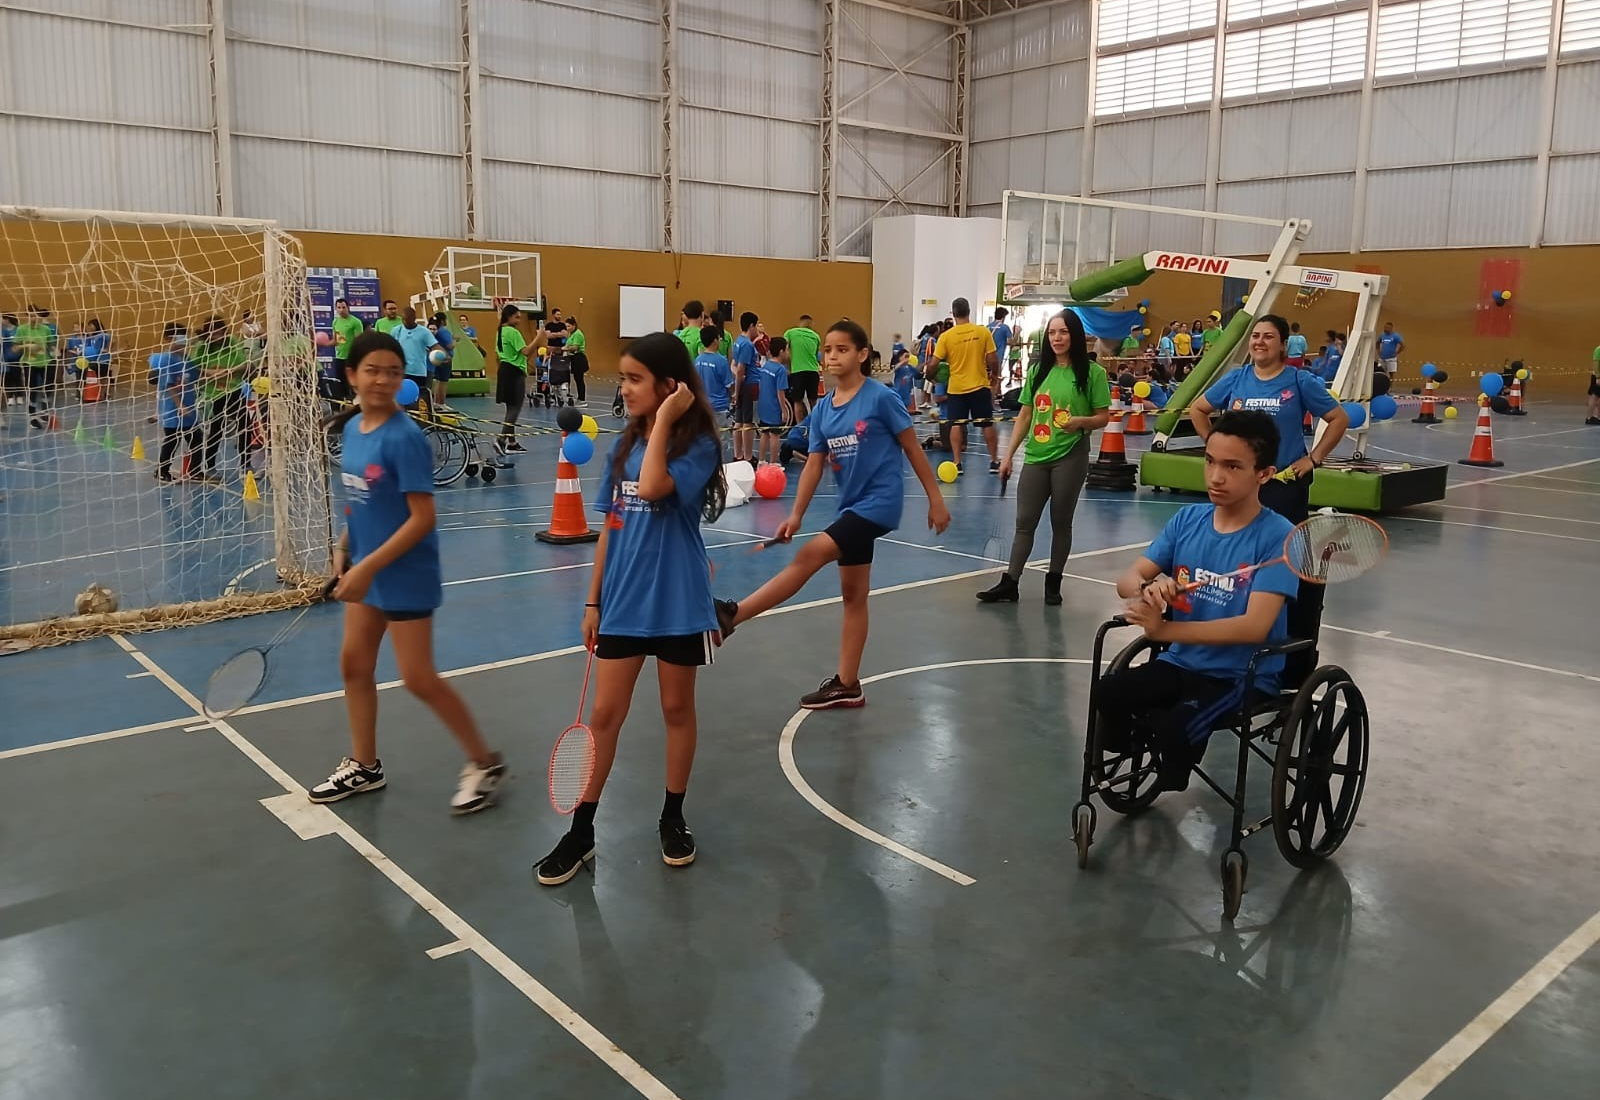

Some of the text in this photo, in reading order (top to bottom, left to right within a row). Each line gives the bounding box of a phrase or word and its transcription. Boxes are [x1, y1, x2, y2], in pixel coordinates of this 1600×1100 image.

[1155, 254, 1230, 274] RAPINI
[1305, 273, 1333, 283] RAPINI
[1245, 398, 1281, 407] FESTIVAL
